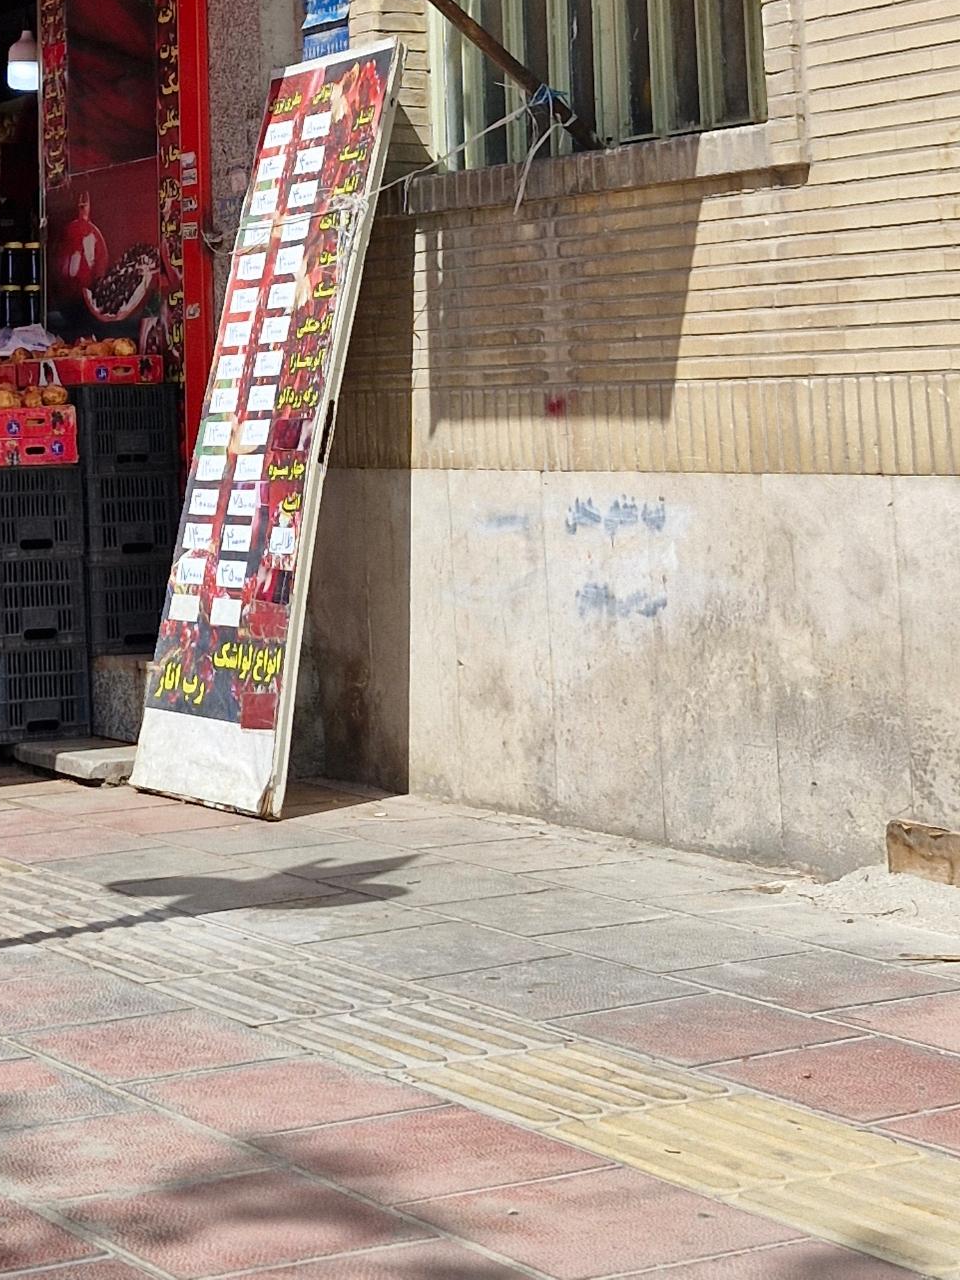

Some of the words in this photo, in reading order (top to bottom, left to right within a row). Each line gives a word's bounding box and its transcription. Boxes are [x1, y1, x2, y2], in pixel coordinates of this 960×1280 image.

[214, 642, 253, 679] لواشک
[254, 648, 281, 682] انواع
[154, 664, 181, 697] انار
[182, 671, 205, 704] رب
